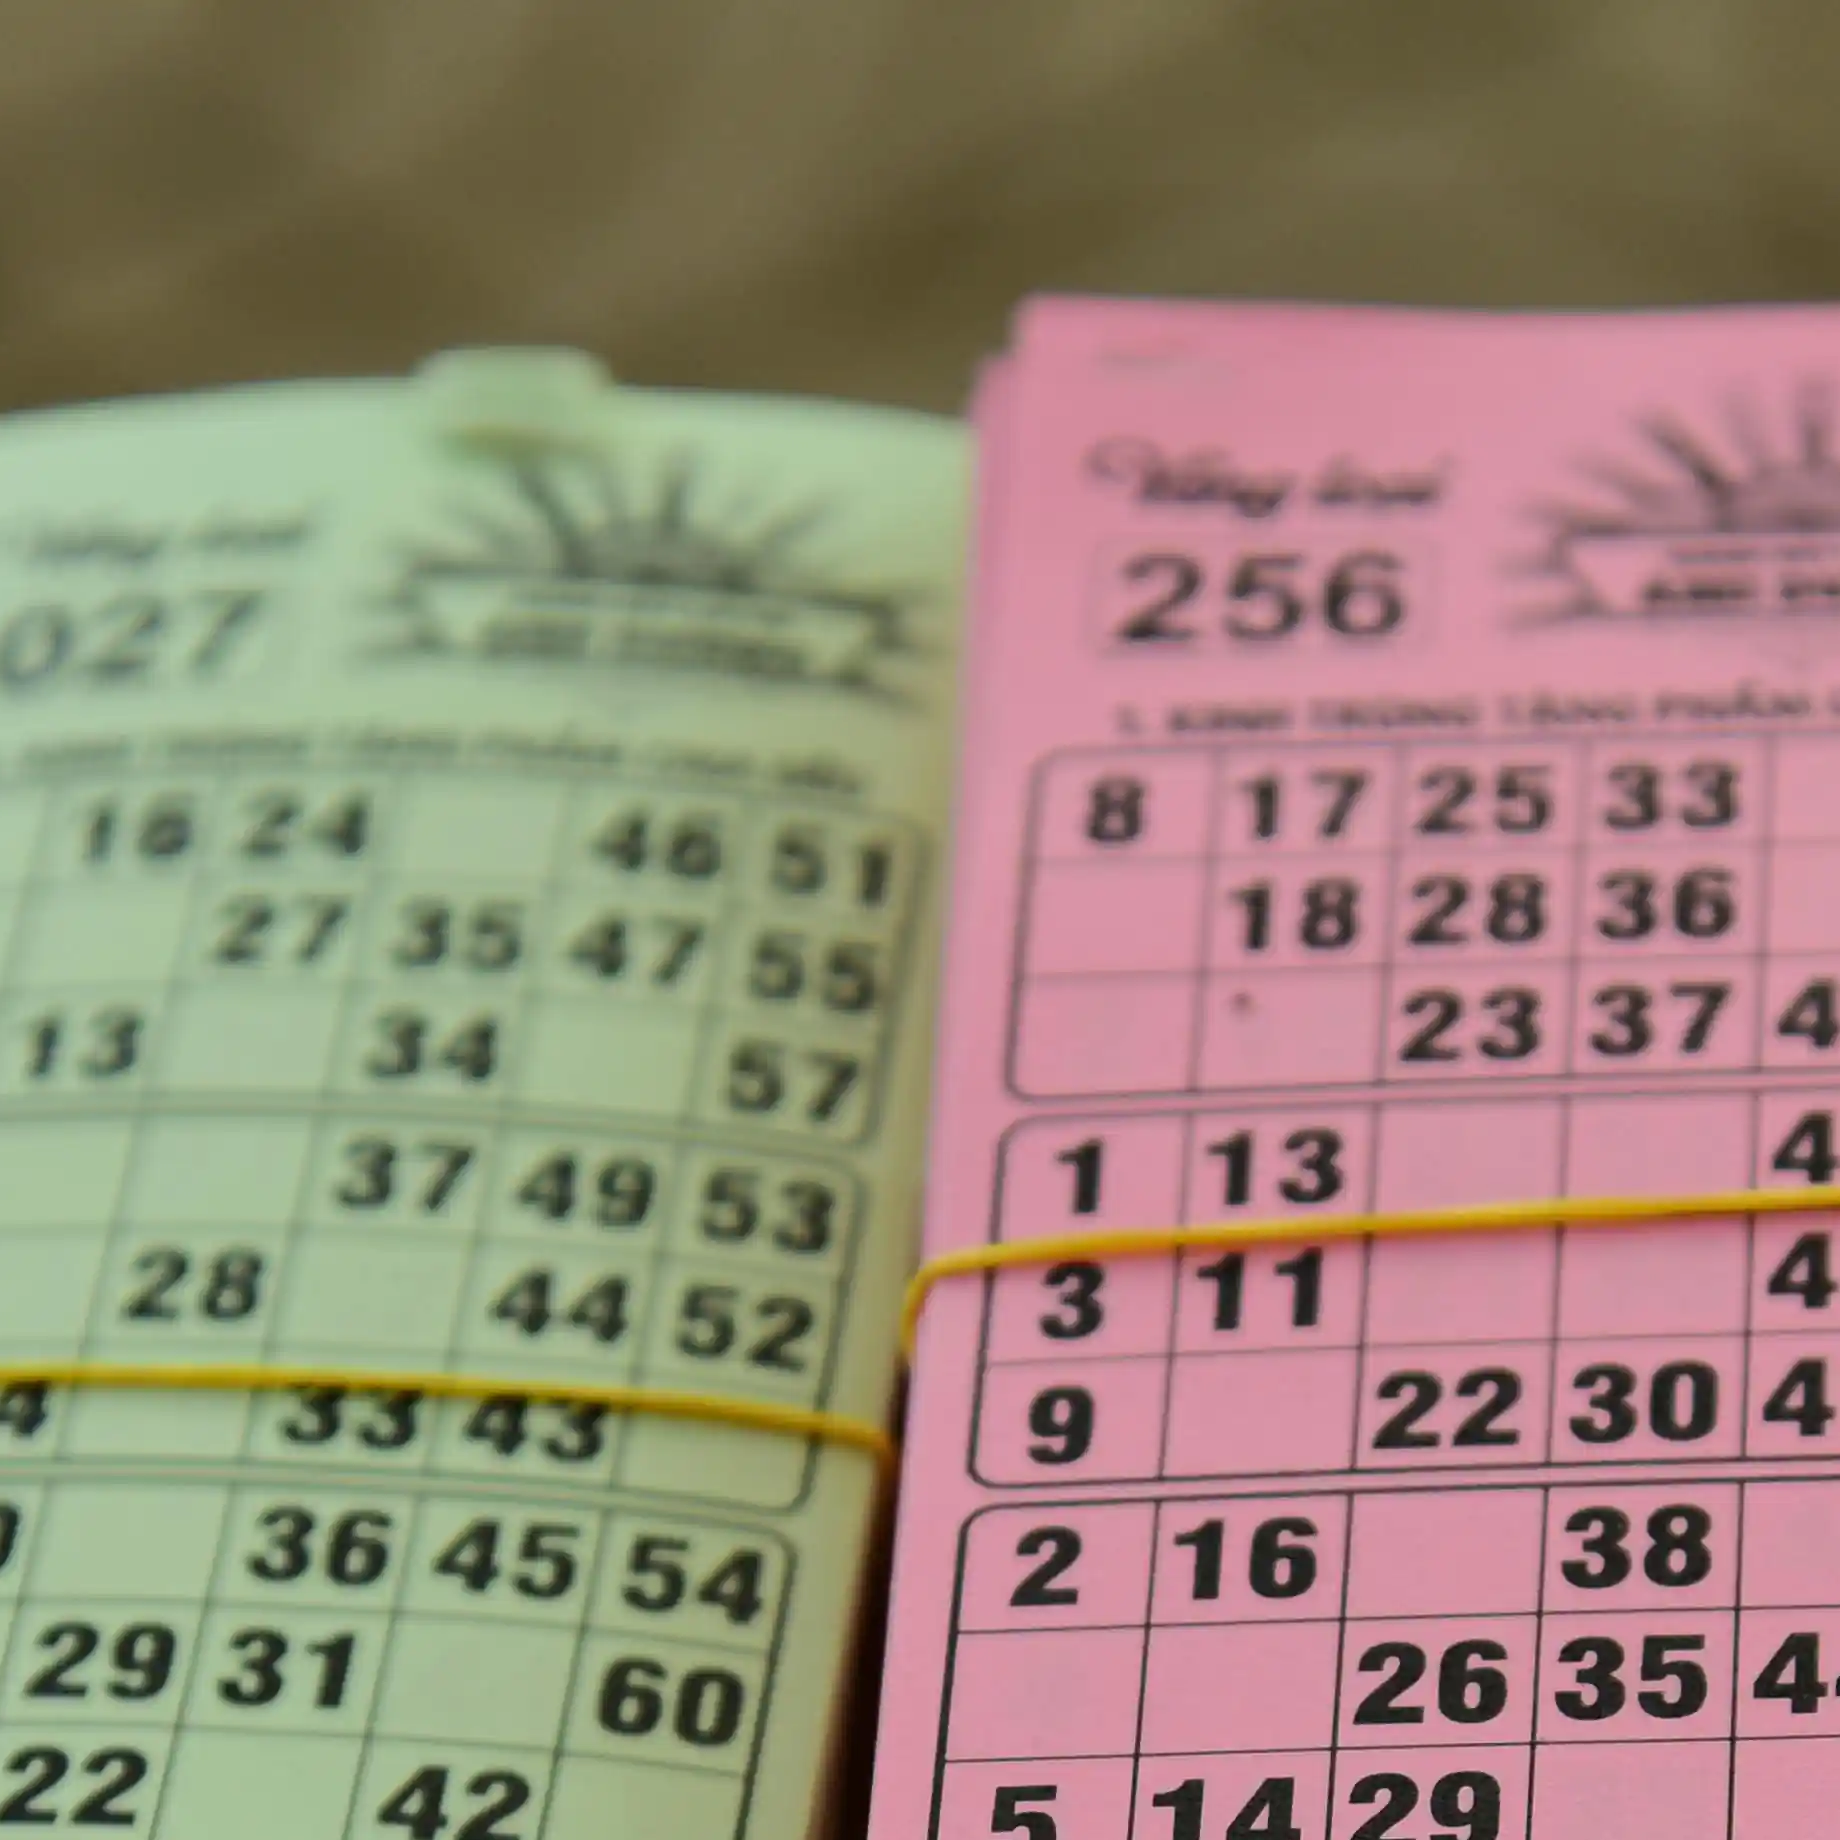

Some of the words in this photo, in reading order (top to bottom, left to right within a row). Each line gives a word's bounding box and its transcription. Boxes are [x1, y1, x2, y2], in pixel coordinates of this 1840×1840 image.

[1115, 551, 1406, 647] 256
[28, 1010, 146, 1081] 13
[367, 1013, 500, 1085] 34
[727, 1041, 869, 1124] 57
[1398, 987, 1541, 1064] 23
[1589, 981, 1732, 1058] 37
[1038, 1253, 1107, 1341] 3
[1194, 1236, 1330, 1332] 11
[1008, 1524, 1083, 1608] 2
[1173, 1516, 1319, 1602] 16
[1560, 1502, 1713, 1591] 38
[24, 1621, 178, 1701] 29
[217, 1627, 357, 1710] 31
[597, 1656, 746, 1748] 60
